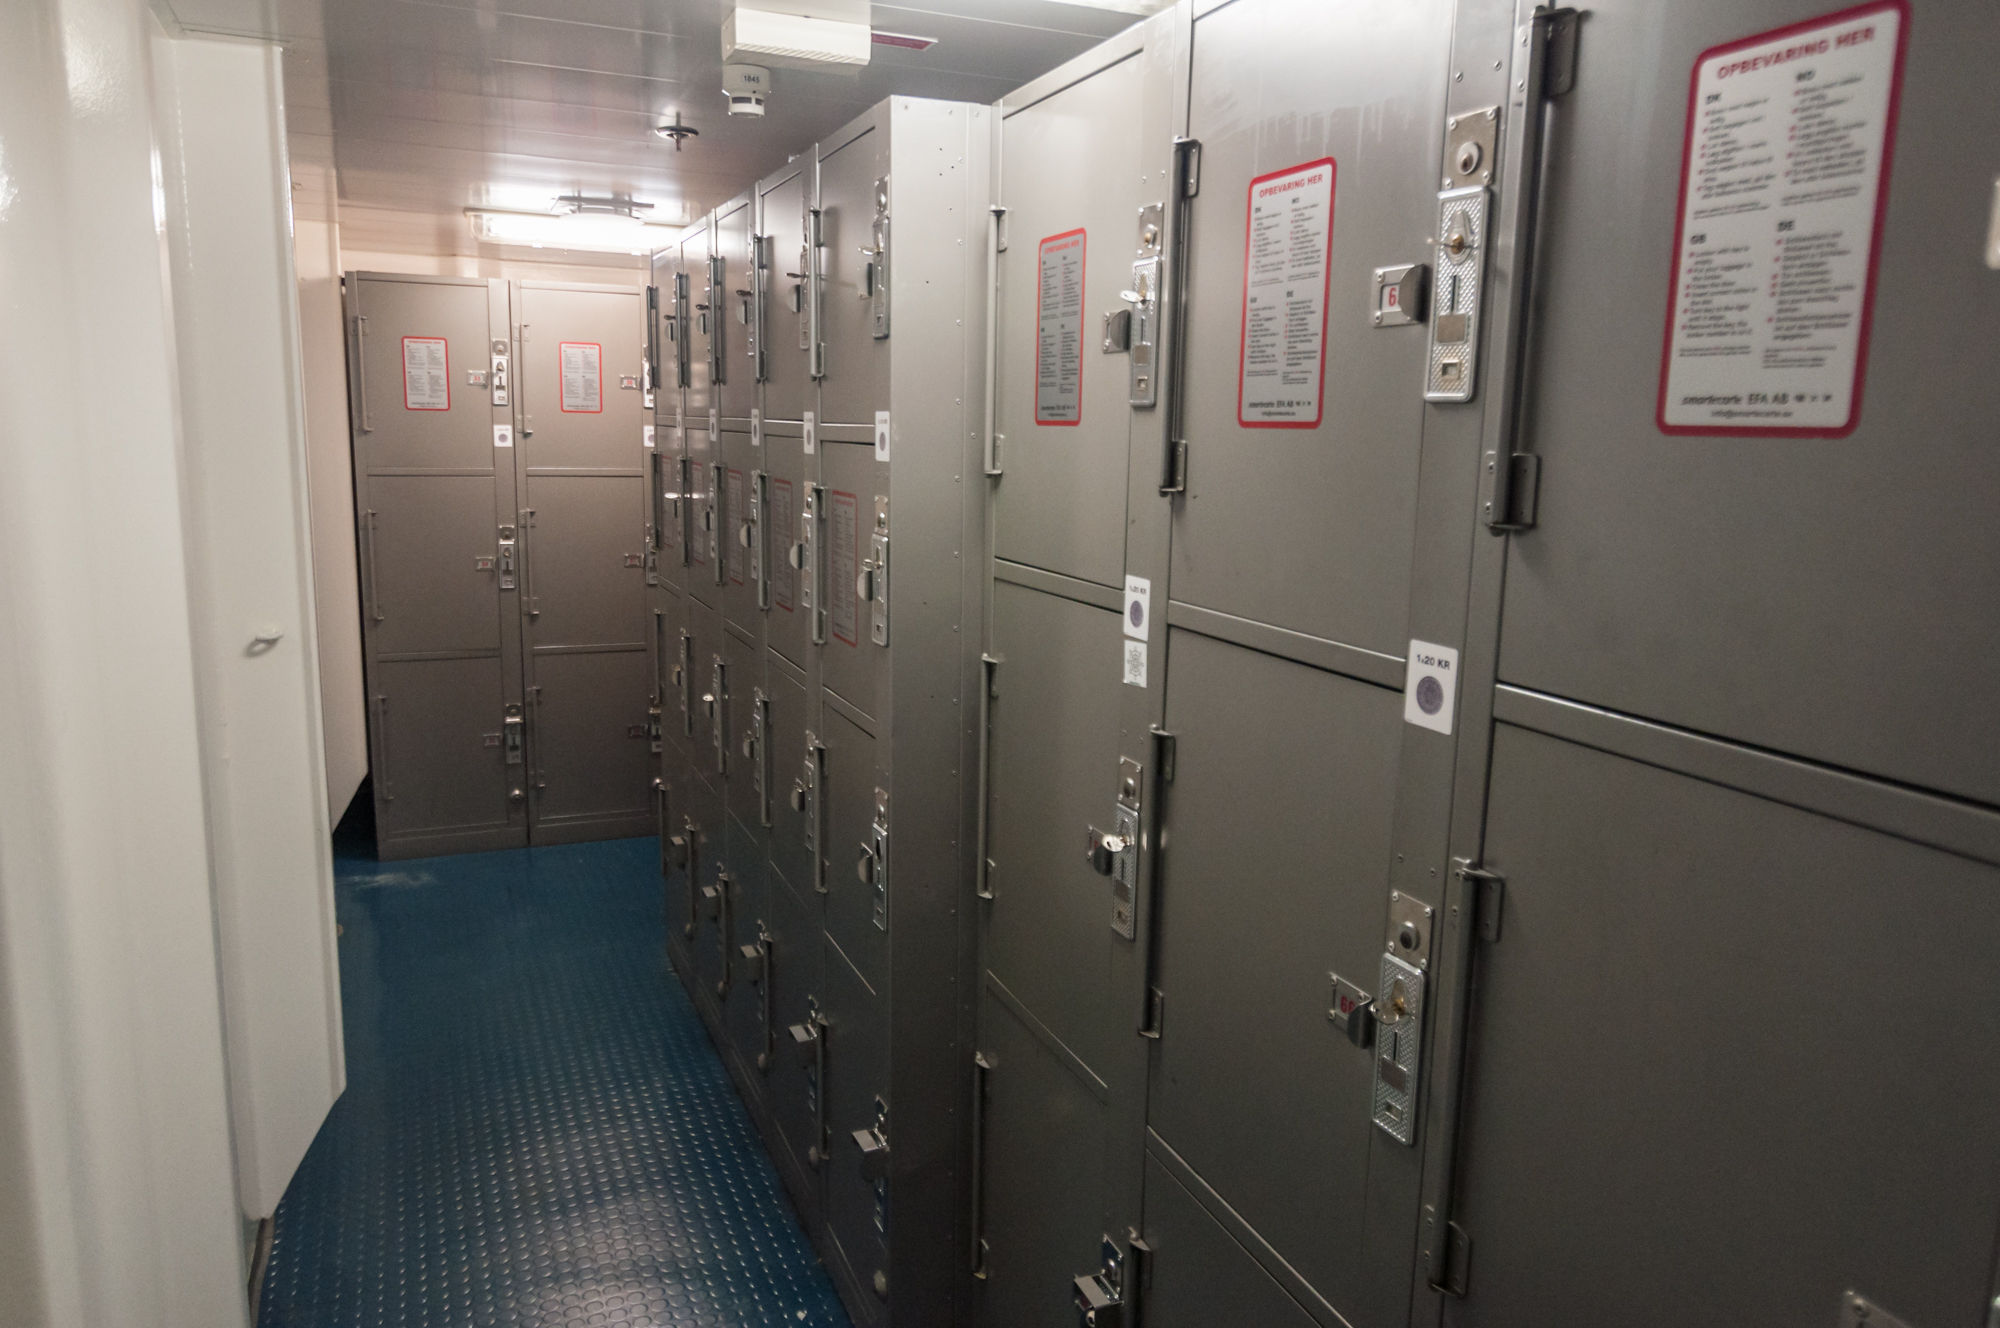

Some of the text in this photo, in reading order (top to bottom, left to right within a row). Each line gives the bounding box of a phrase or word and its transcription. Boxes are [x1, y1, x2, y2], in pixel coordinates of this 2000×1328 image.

[1717, 26, 1876, 80] OPBEVARING HER
[1259, 173, 1323, 198] OPBEVARING HER
[1438, 659, 1450, 670] KR
